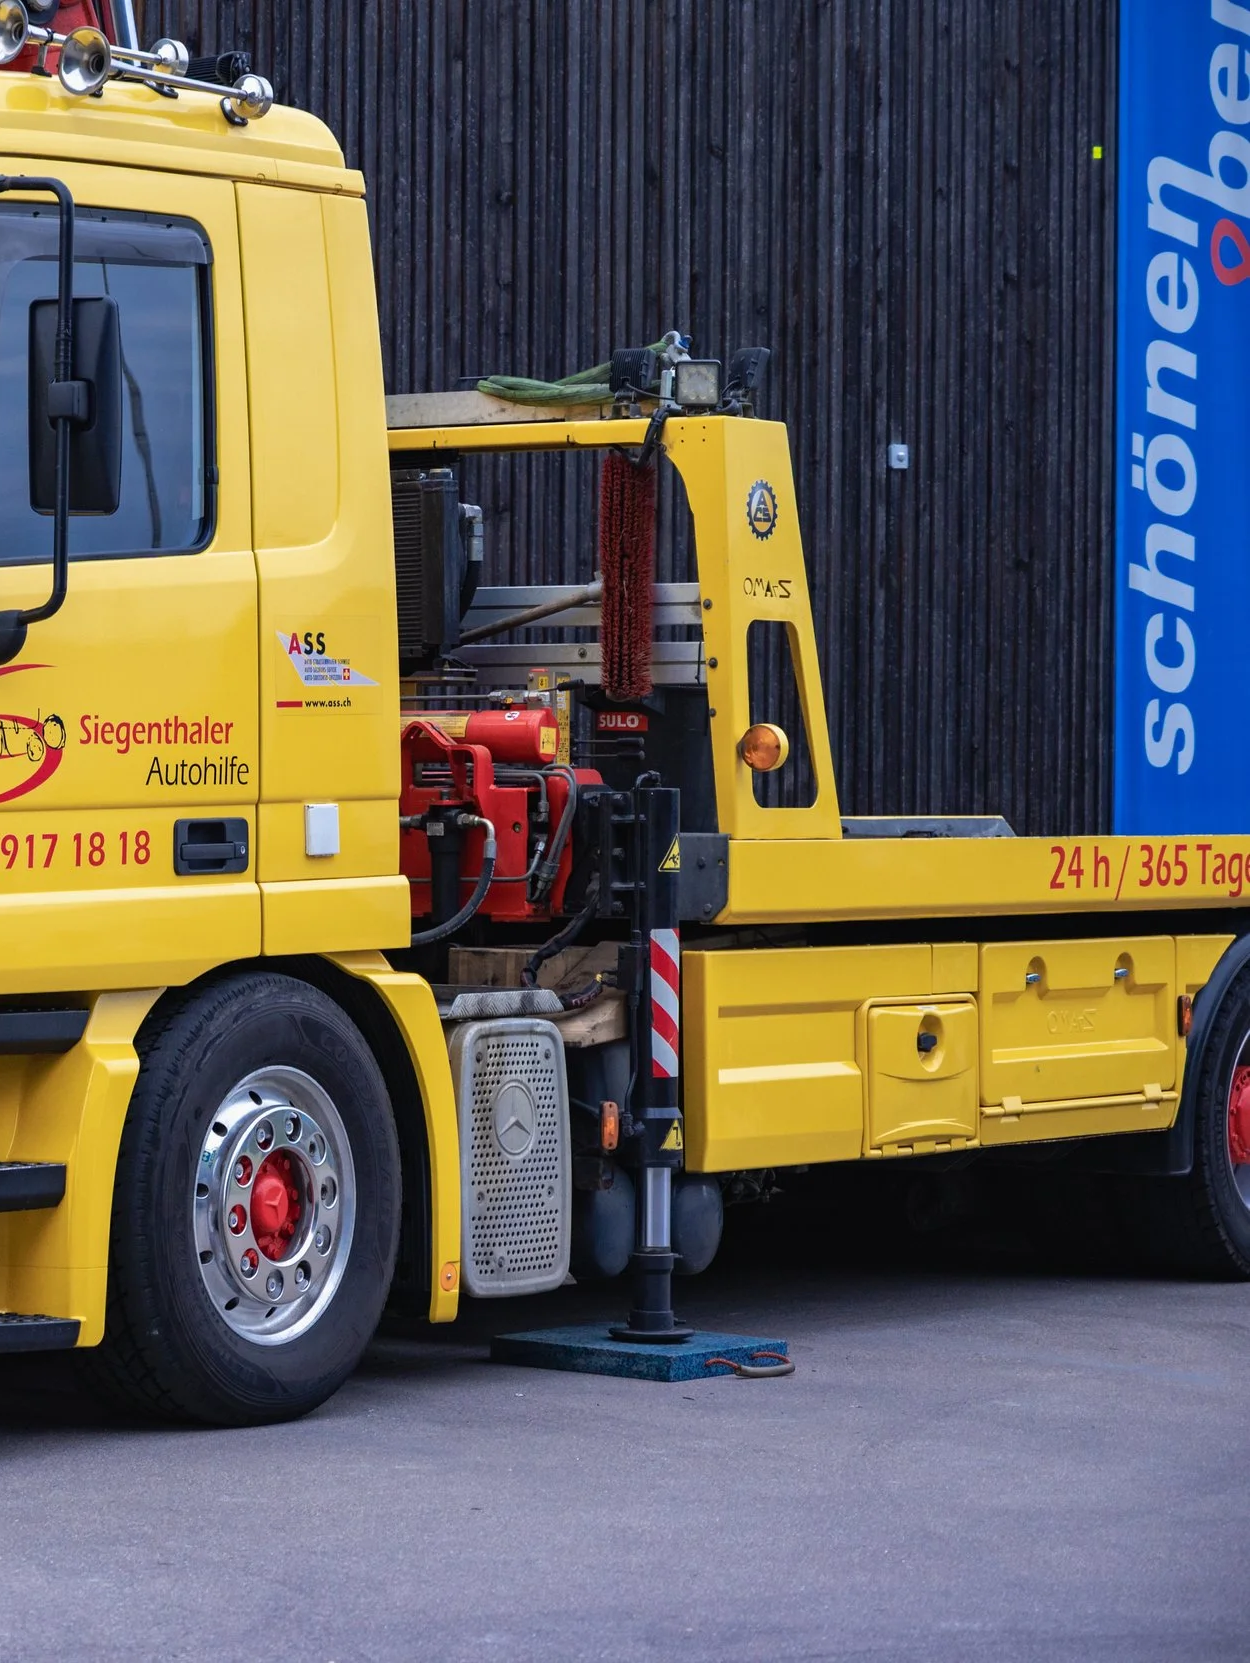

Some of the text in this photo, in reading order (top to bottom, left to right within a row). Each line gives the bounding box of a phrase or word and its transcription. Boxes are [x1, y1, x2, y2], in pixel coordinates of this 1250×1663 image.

[1128, 155, 1200, 775] schönen
[288, 632, 326, 655] ASS
[304, 697, 352, 708] www.ass.ch
[79, 714, 234, 755] Siegenthaler
[599, 714, 639, 729] SULO
[145, 755, 249, 786] Autohilfe
[0, 833, 59, 870] 917
[73, 831, 106, 867] 18
[119, 829, 151, 866] 18
[1049, 843, 1250, 901] 24 h / 365 Tage
